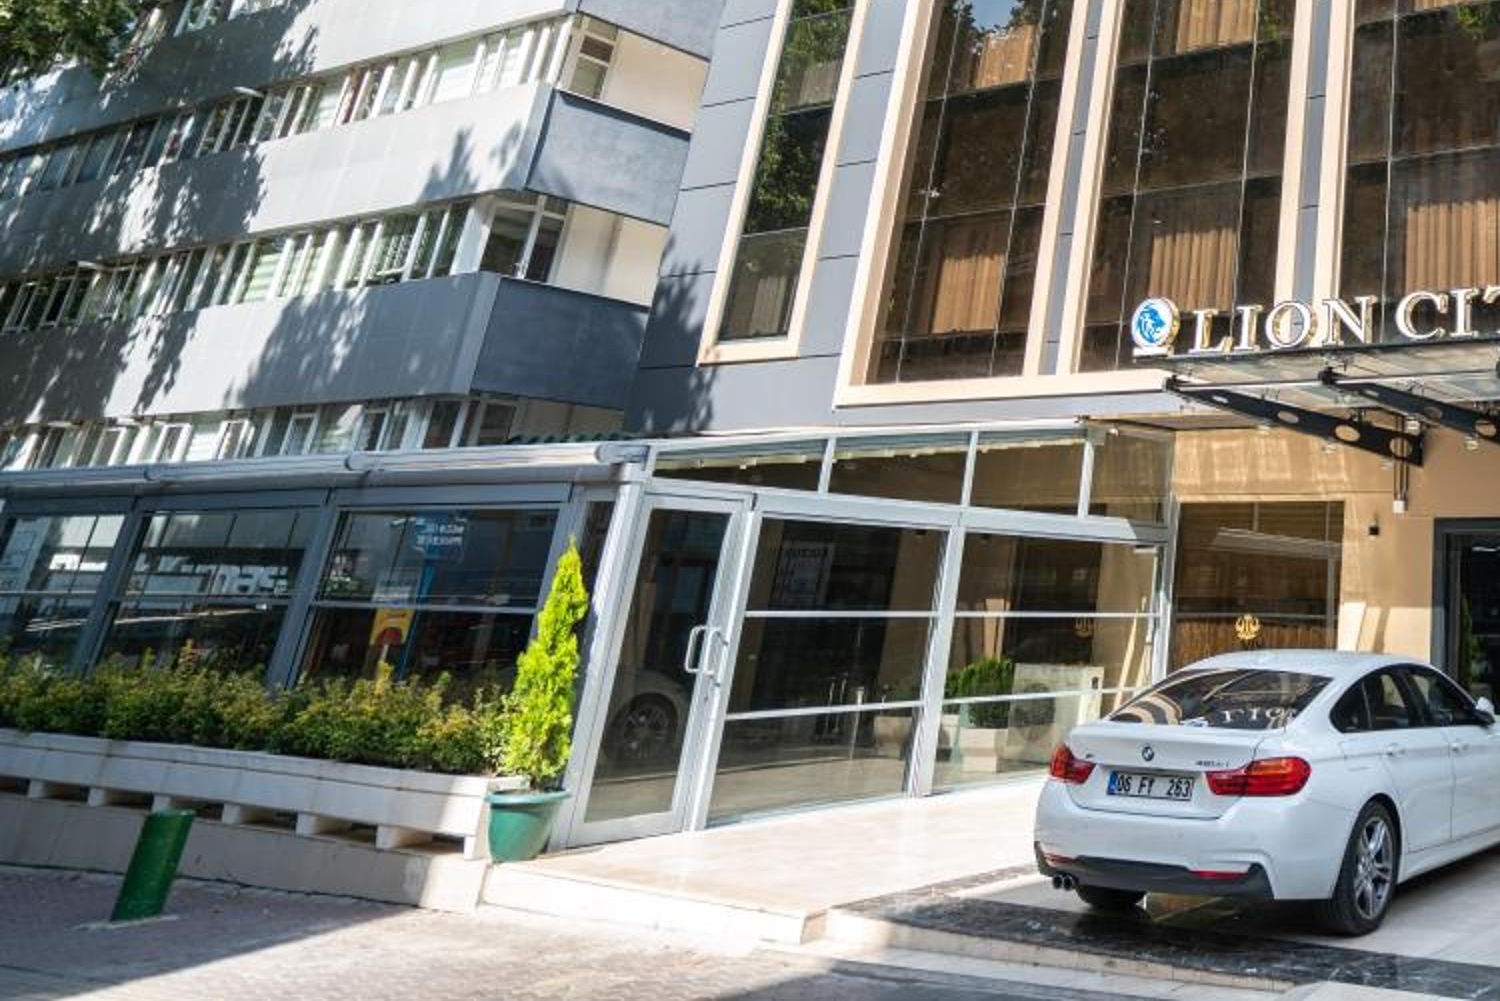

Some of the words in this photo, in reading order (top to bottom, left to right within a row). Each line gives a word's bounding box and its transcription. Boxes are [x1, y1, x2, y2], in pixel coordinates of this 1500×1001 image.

[1188, 295, 1379, 354] LION
[1115, 773, 1132, 792] 06
[1166, 778, 1191, 798] 263
